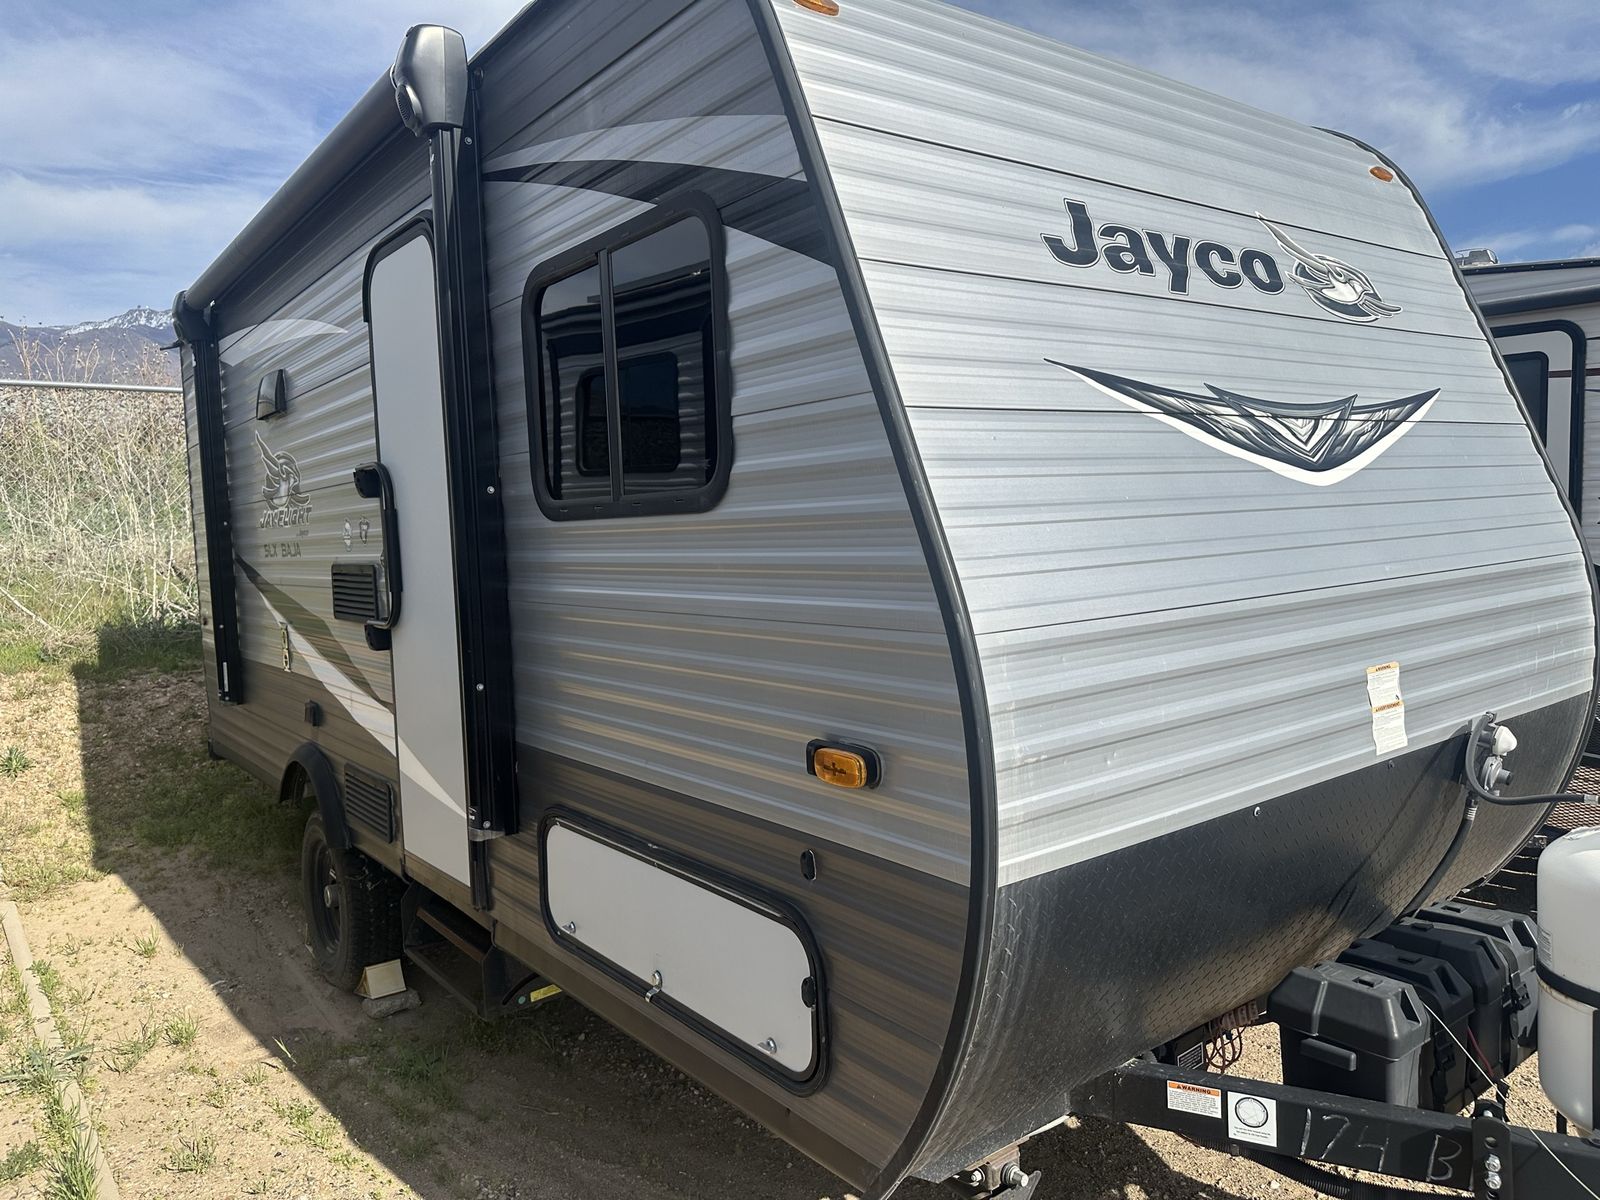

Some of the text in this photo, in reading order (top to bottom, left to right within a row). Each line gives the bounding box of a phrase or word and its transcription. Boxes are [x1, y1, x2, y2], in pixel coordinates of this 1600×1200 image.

[1040, 197, 1285, 296] Jayco
[264, 543, 302, 558] SLX BAJA
[1181, 1085, 1211, 1095] WARNING
[1300, 1108, 1390, 1172] 174
